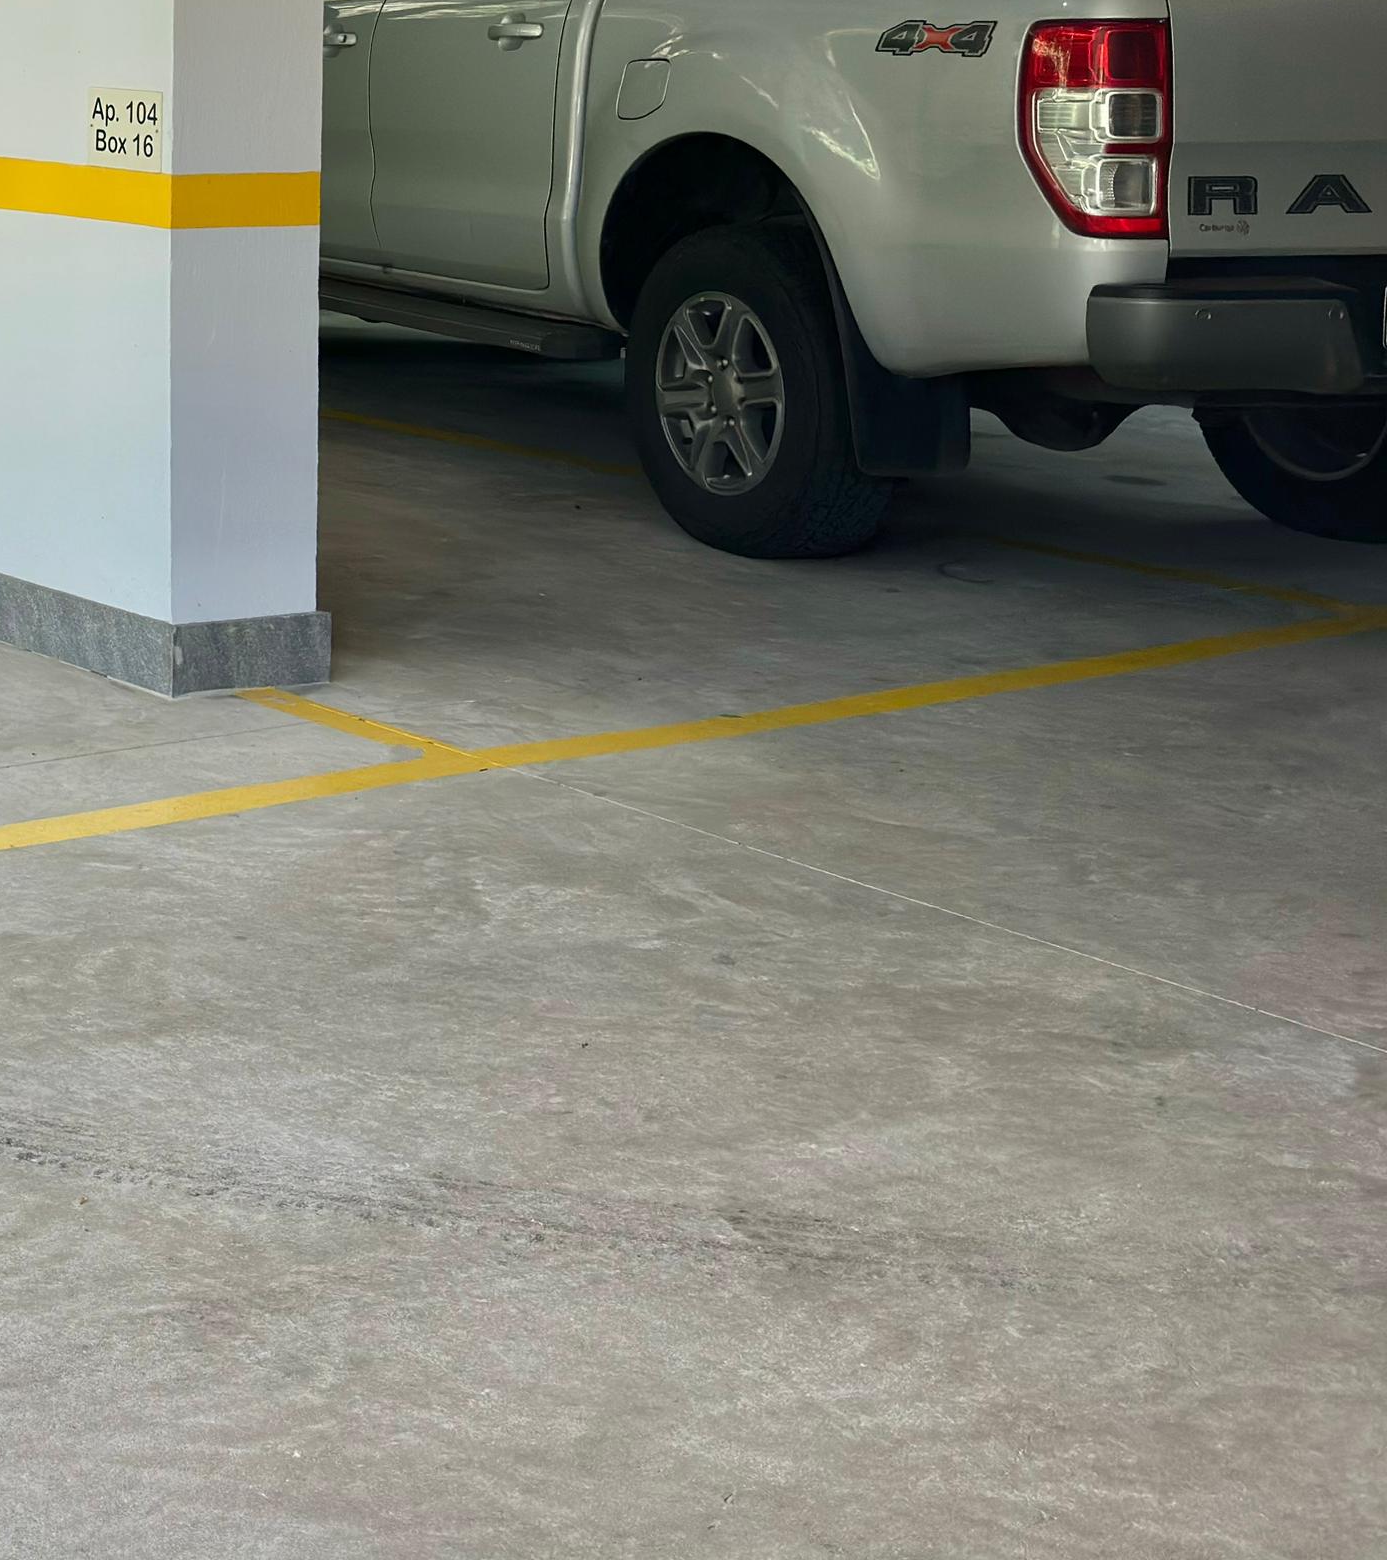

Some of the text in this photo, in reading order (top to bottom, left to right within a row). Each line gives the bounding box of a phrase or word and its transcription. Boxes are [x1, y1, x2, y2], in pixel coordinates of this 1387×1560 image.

[92, 97, 158, 126] Ap. 104
[95, 129, 153, 157] Box 16
